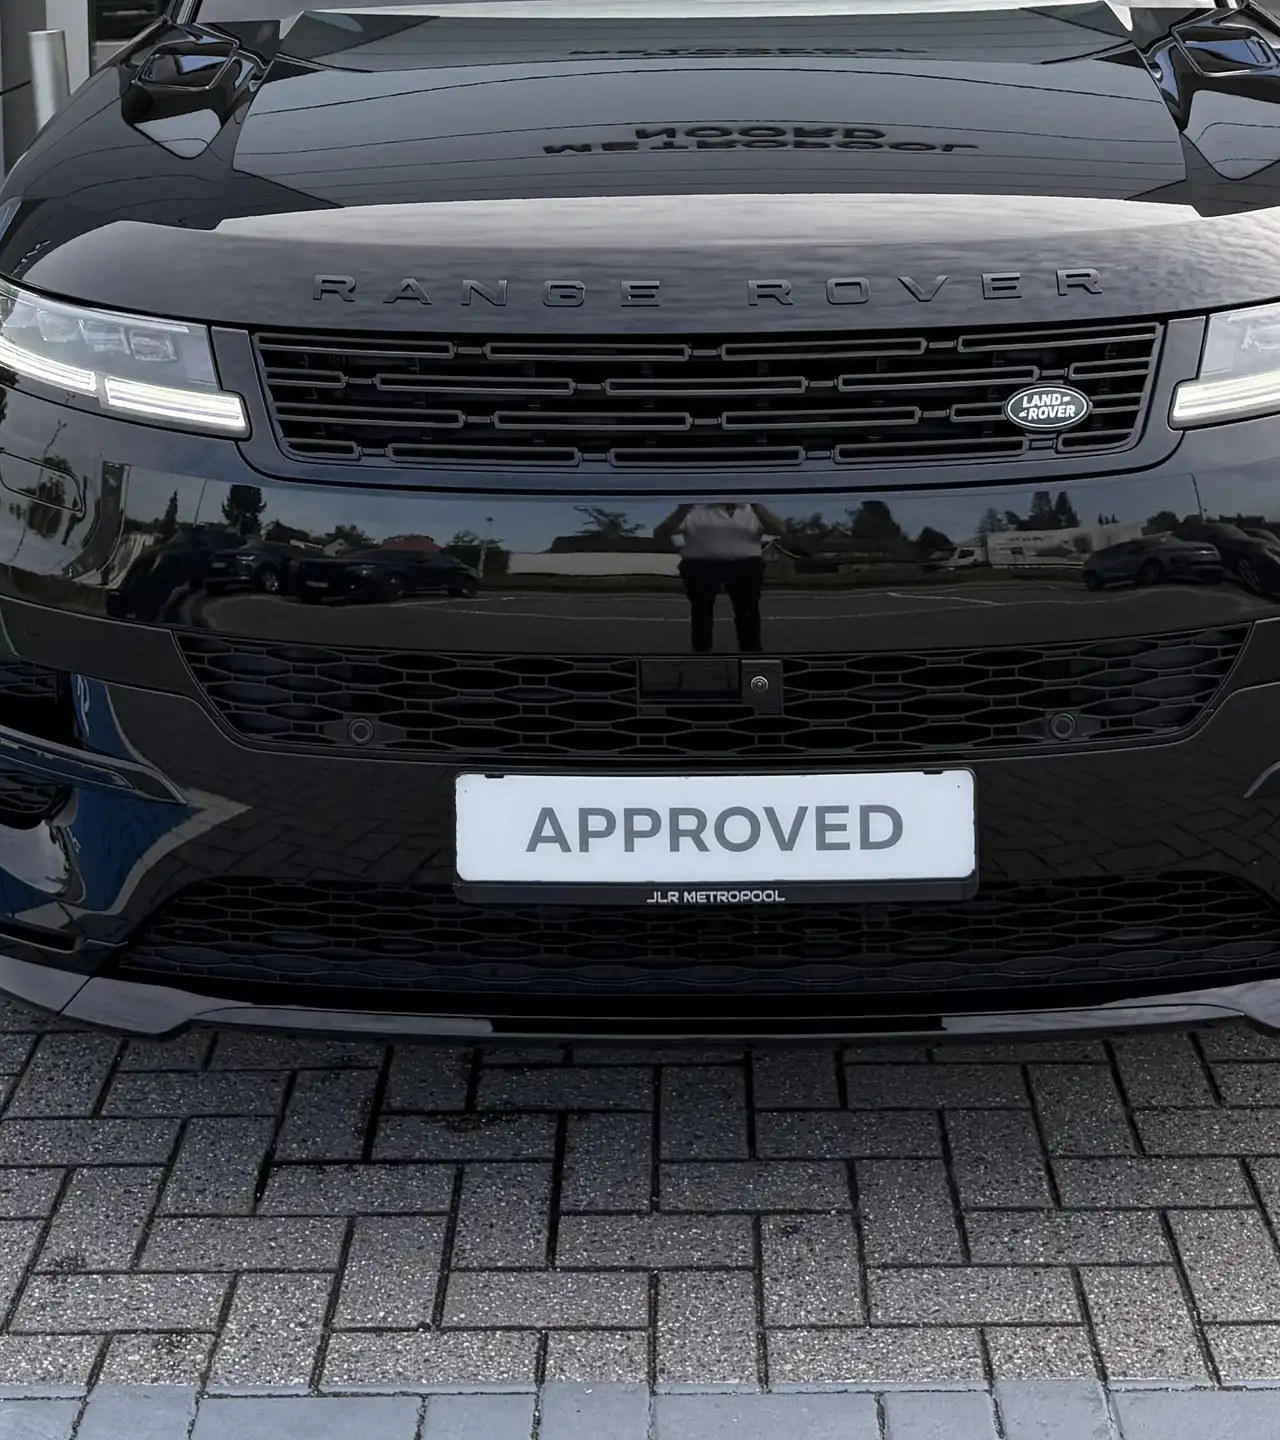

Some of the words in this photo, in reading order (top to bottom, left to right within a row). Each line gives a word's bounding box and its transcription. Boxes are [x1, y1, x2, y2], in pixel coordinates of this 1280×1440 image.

[312, 274, 662, 308] RANGE
[746, 267, 1103, 307] ROVER
[1023, 394, 1062, 408] LAND
[1027, 405, 1076, 420] ROVER
[526, 804, 904, 854] APPROVED
[647, 890, 679, 904] JLR
[683, 890, 786, 903] METROPOOL
